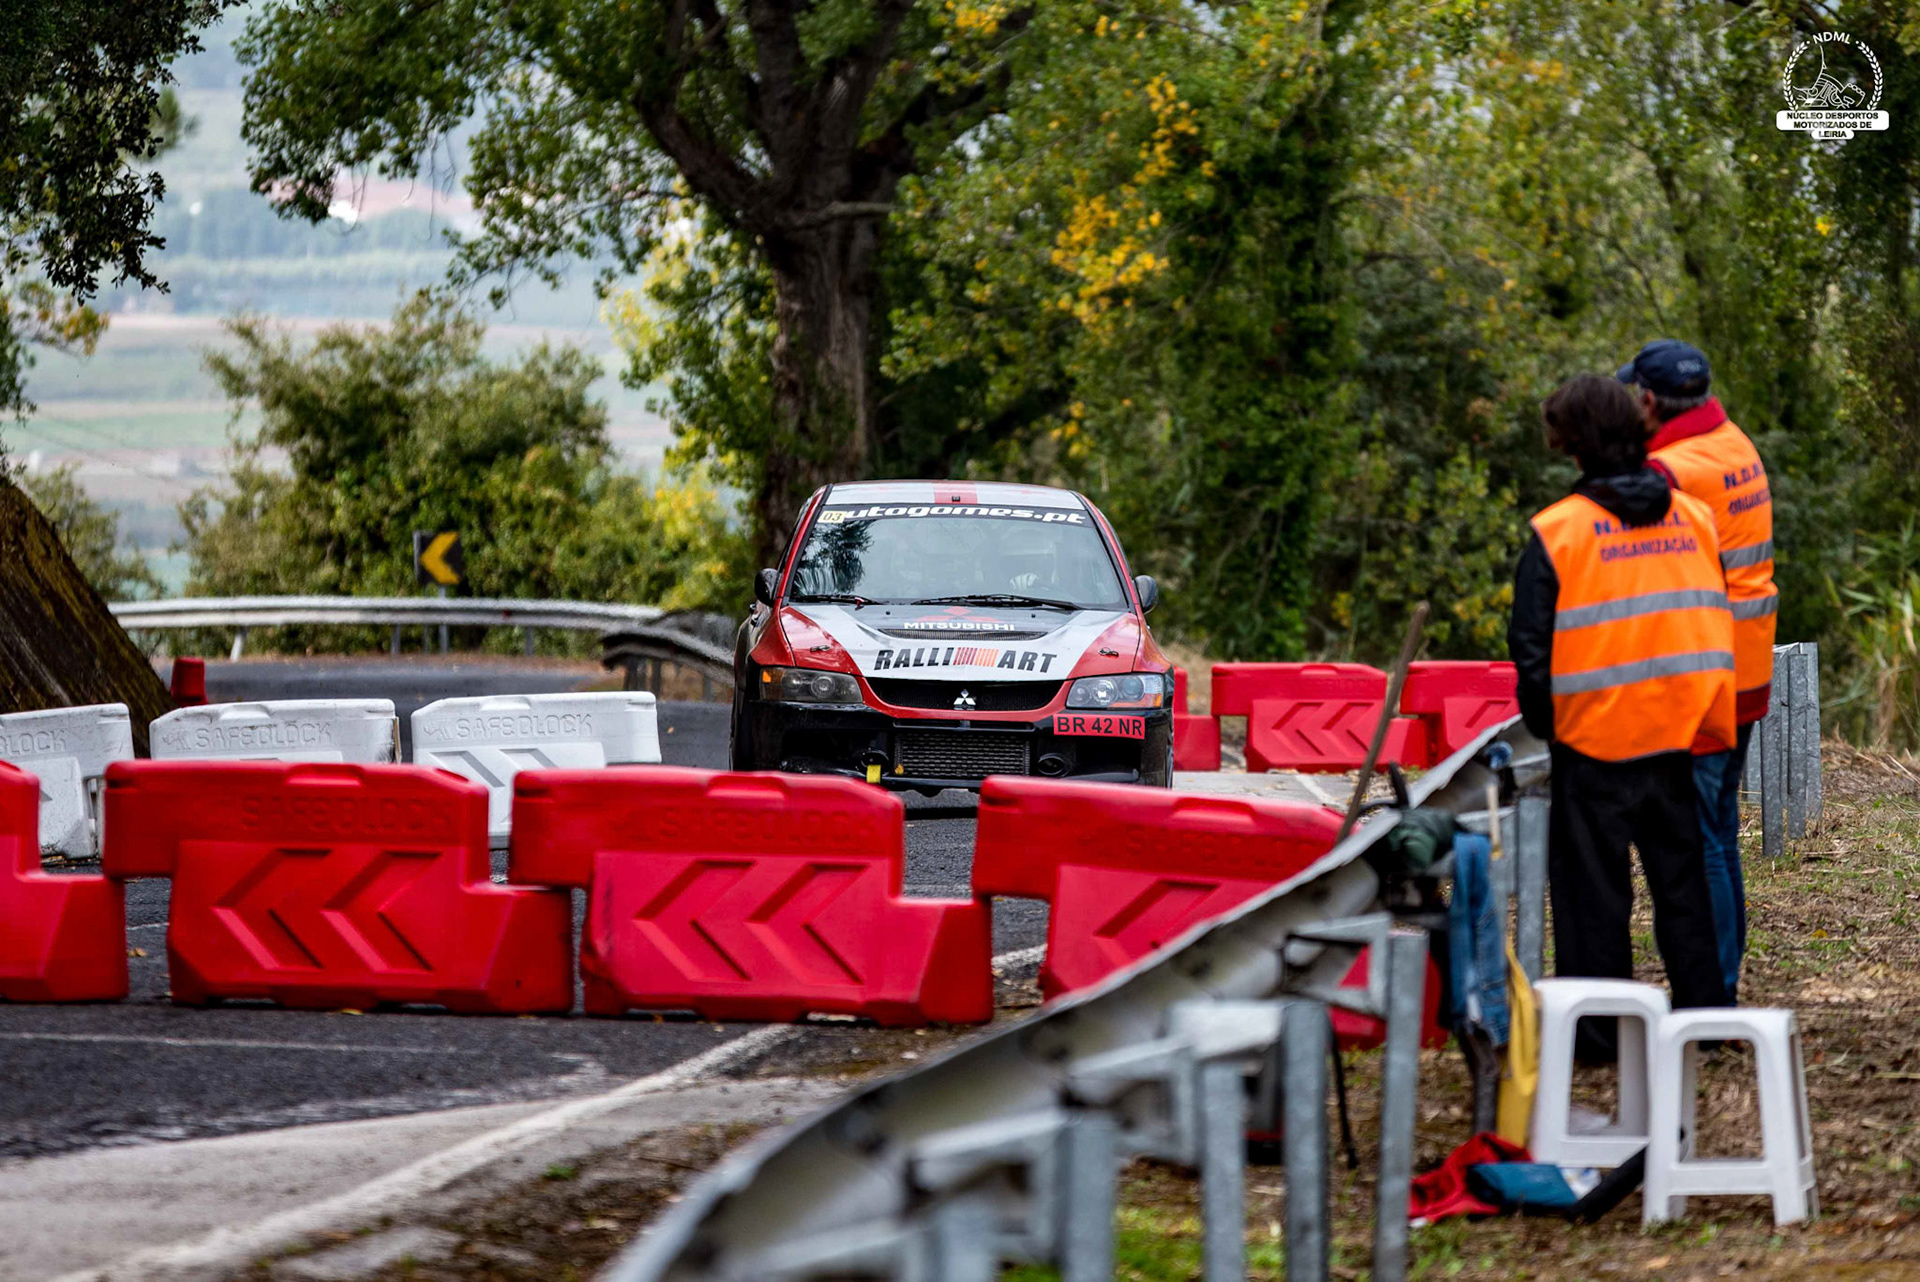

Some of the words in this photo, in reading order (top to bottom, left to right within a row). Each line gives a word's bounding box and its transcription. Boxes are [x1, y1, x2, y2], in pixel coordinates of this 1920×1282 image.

[822, 511, 842, 521] 03
[845, 505, 1085, 524] utogomes.pt
[904, 622, 1015, 631] MITSUBISHI
[1057, 716, 1086, 733] BR
[1092, 717, 1113, 734] 42
[1119, 718, 1142, 736] NR
